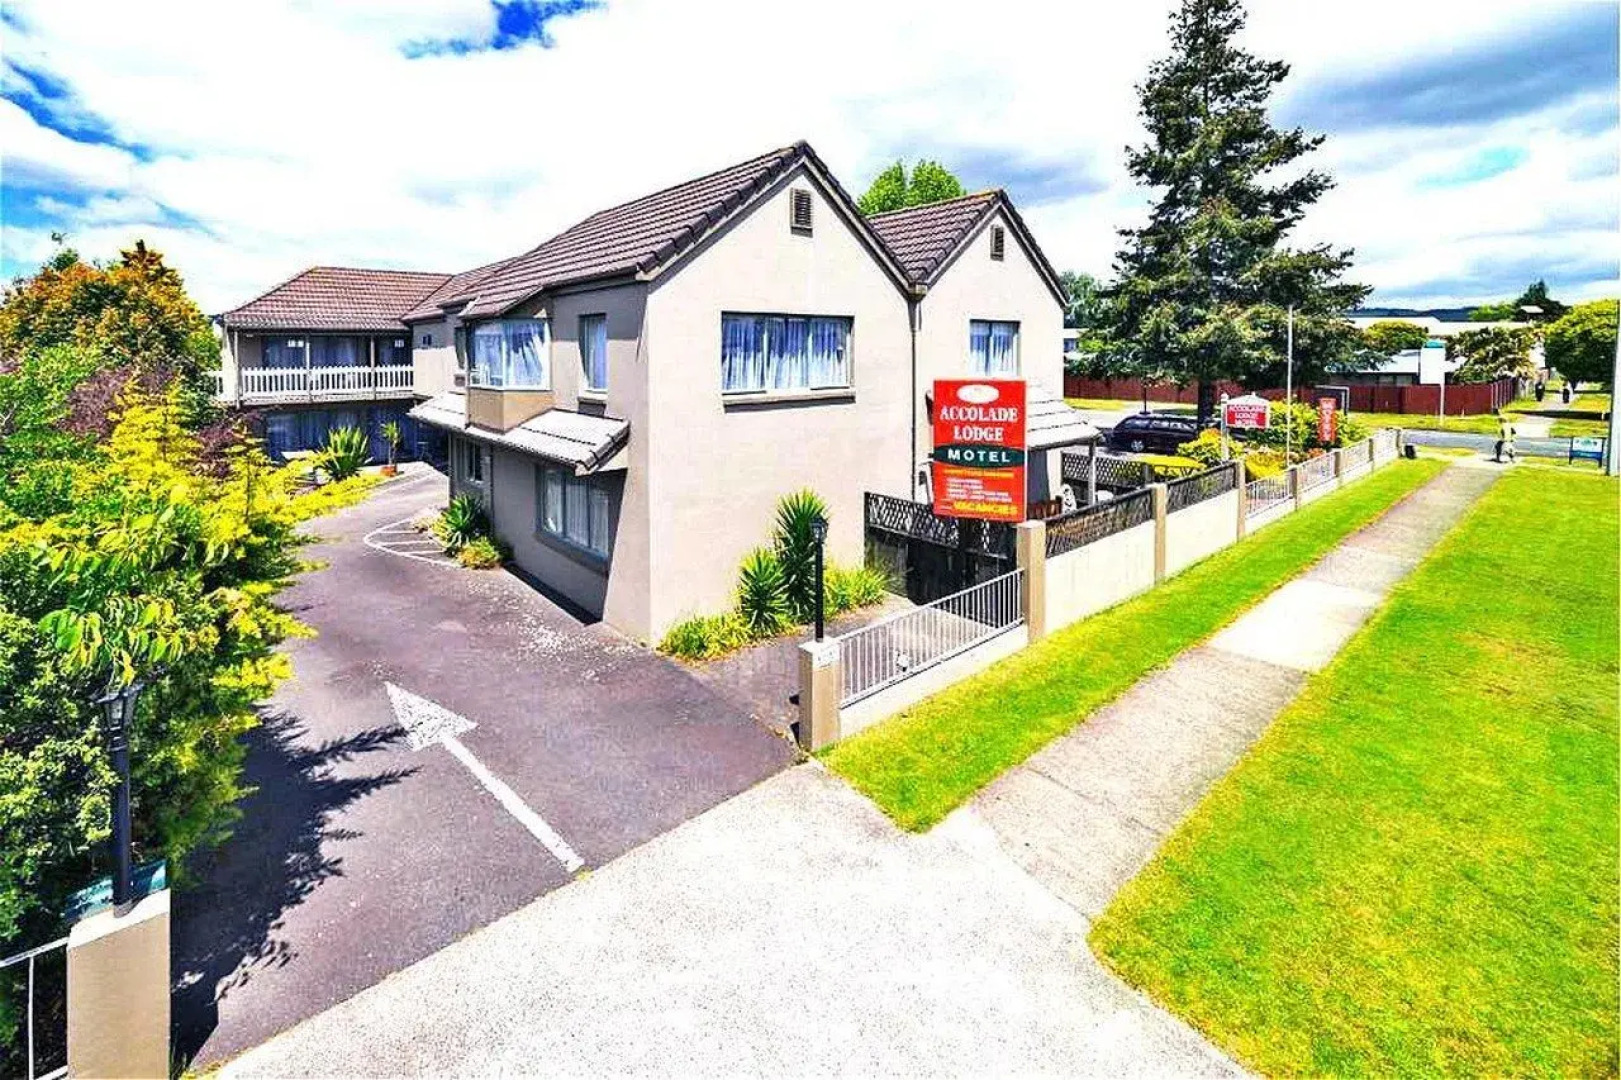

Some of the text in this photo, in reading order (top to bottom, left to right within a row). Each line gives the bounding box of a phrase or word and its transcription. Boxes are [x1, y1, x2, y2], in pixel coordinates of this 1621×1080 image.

[940, 406, 1018, 423] ACCOLADE
[953, 426, 1004, 441] LODGE
[947, 448, 1011, 463] MOTEL
